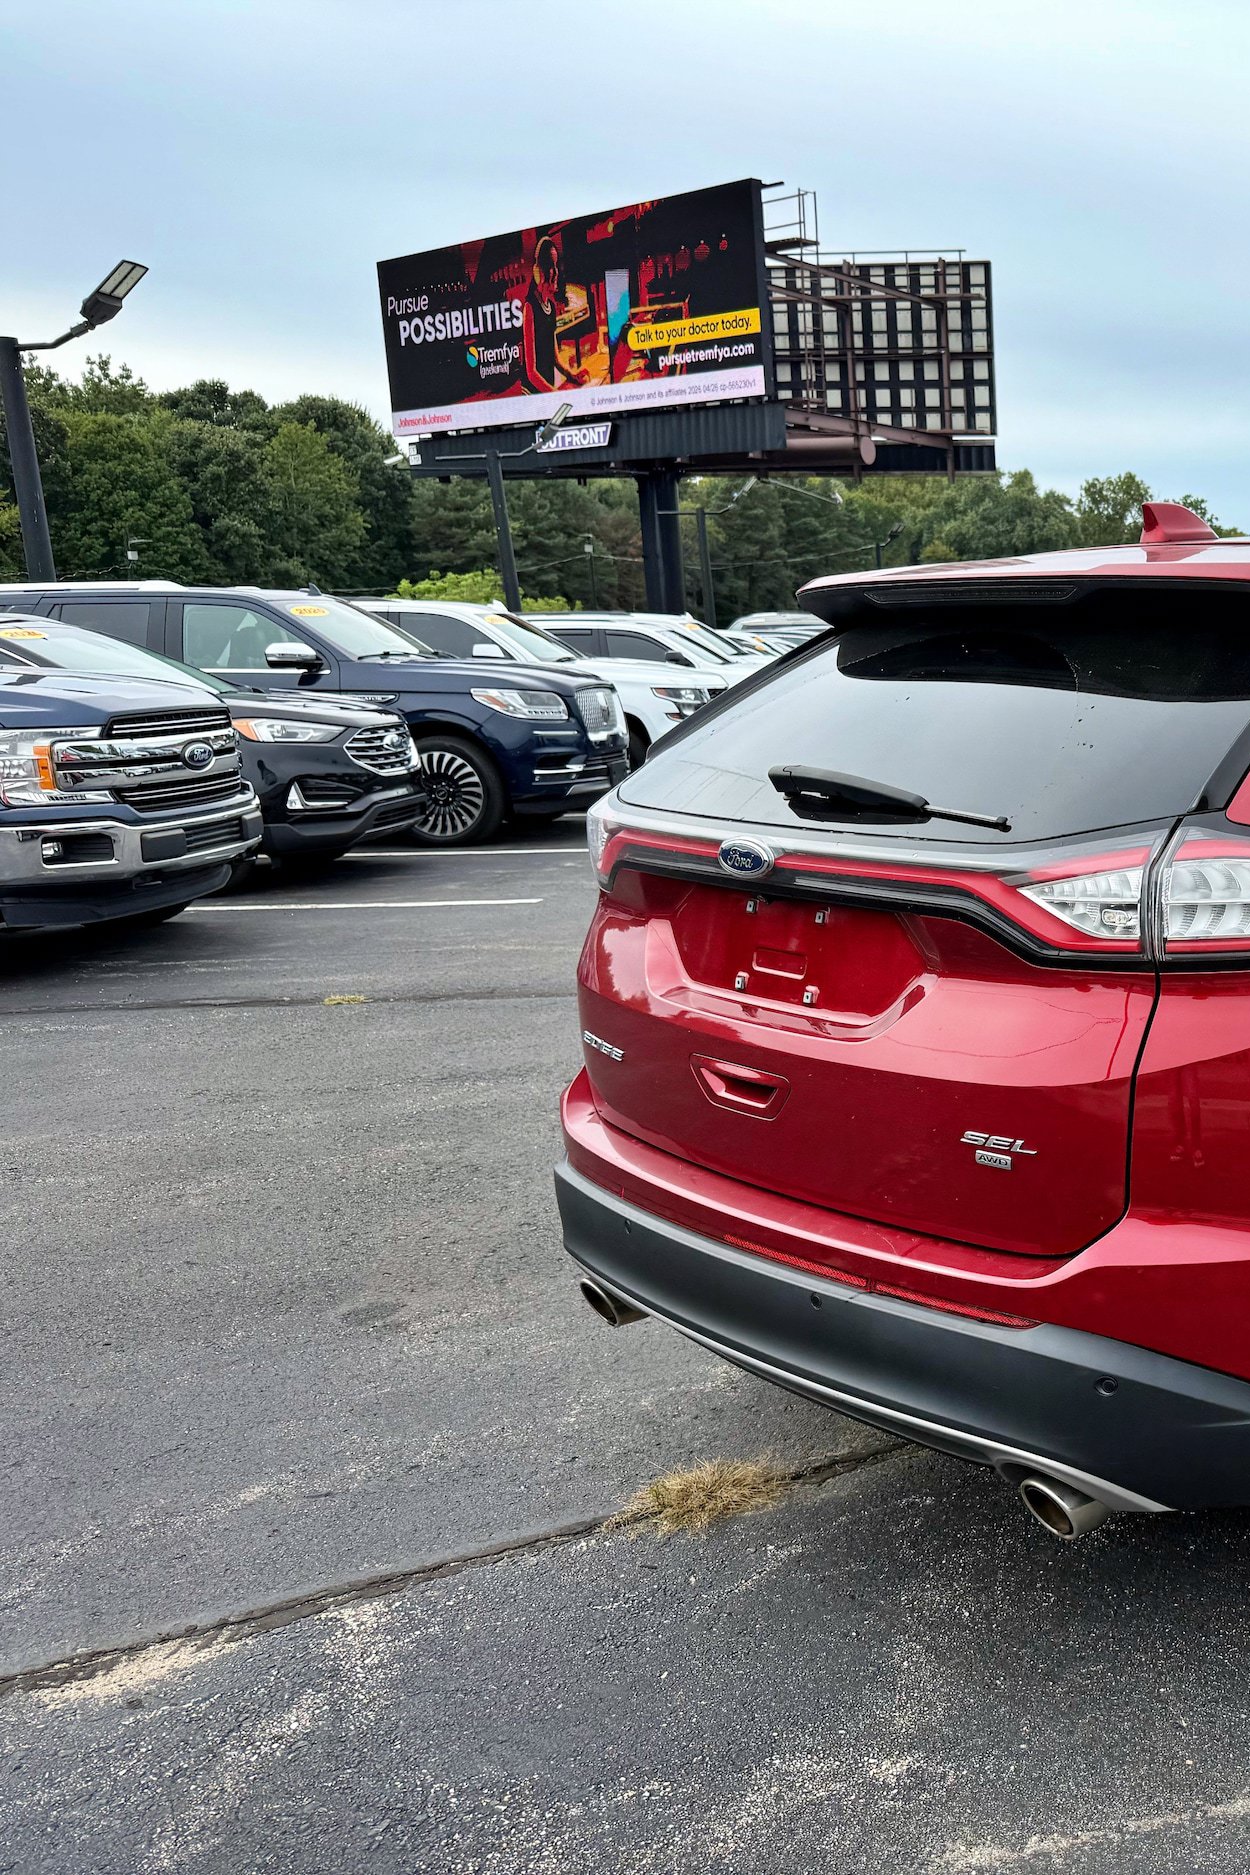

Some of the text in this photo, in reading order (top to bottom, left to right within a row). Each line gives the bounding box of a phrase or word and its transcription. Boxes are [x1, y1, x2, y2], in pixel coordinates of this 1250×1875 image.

[387, 294, 429, 317] Pursue
[399, 299, 523, 347] POSSIBILITIES
[635, 316, 752, 343] Talk to your doctor today.
[477, 342, 520, 363] Tremfya
[658, 342, 755, 370] pursuetremfya.com
[539, 426, 607, 450] UTFRONT
[193, 748, 210, 761] Ford
[726, 846, 755, 869] Ford
[583, 1030, 625, 1062] EDGE
[960, 1131, 1038, 1155] SEL
[977, 1154, 1008, 1166] AWD
